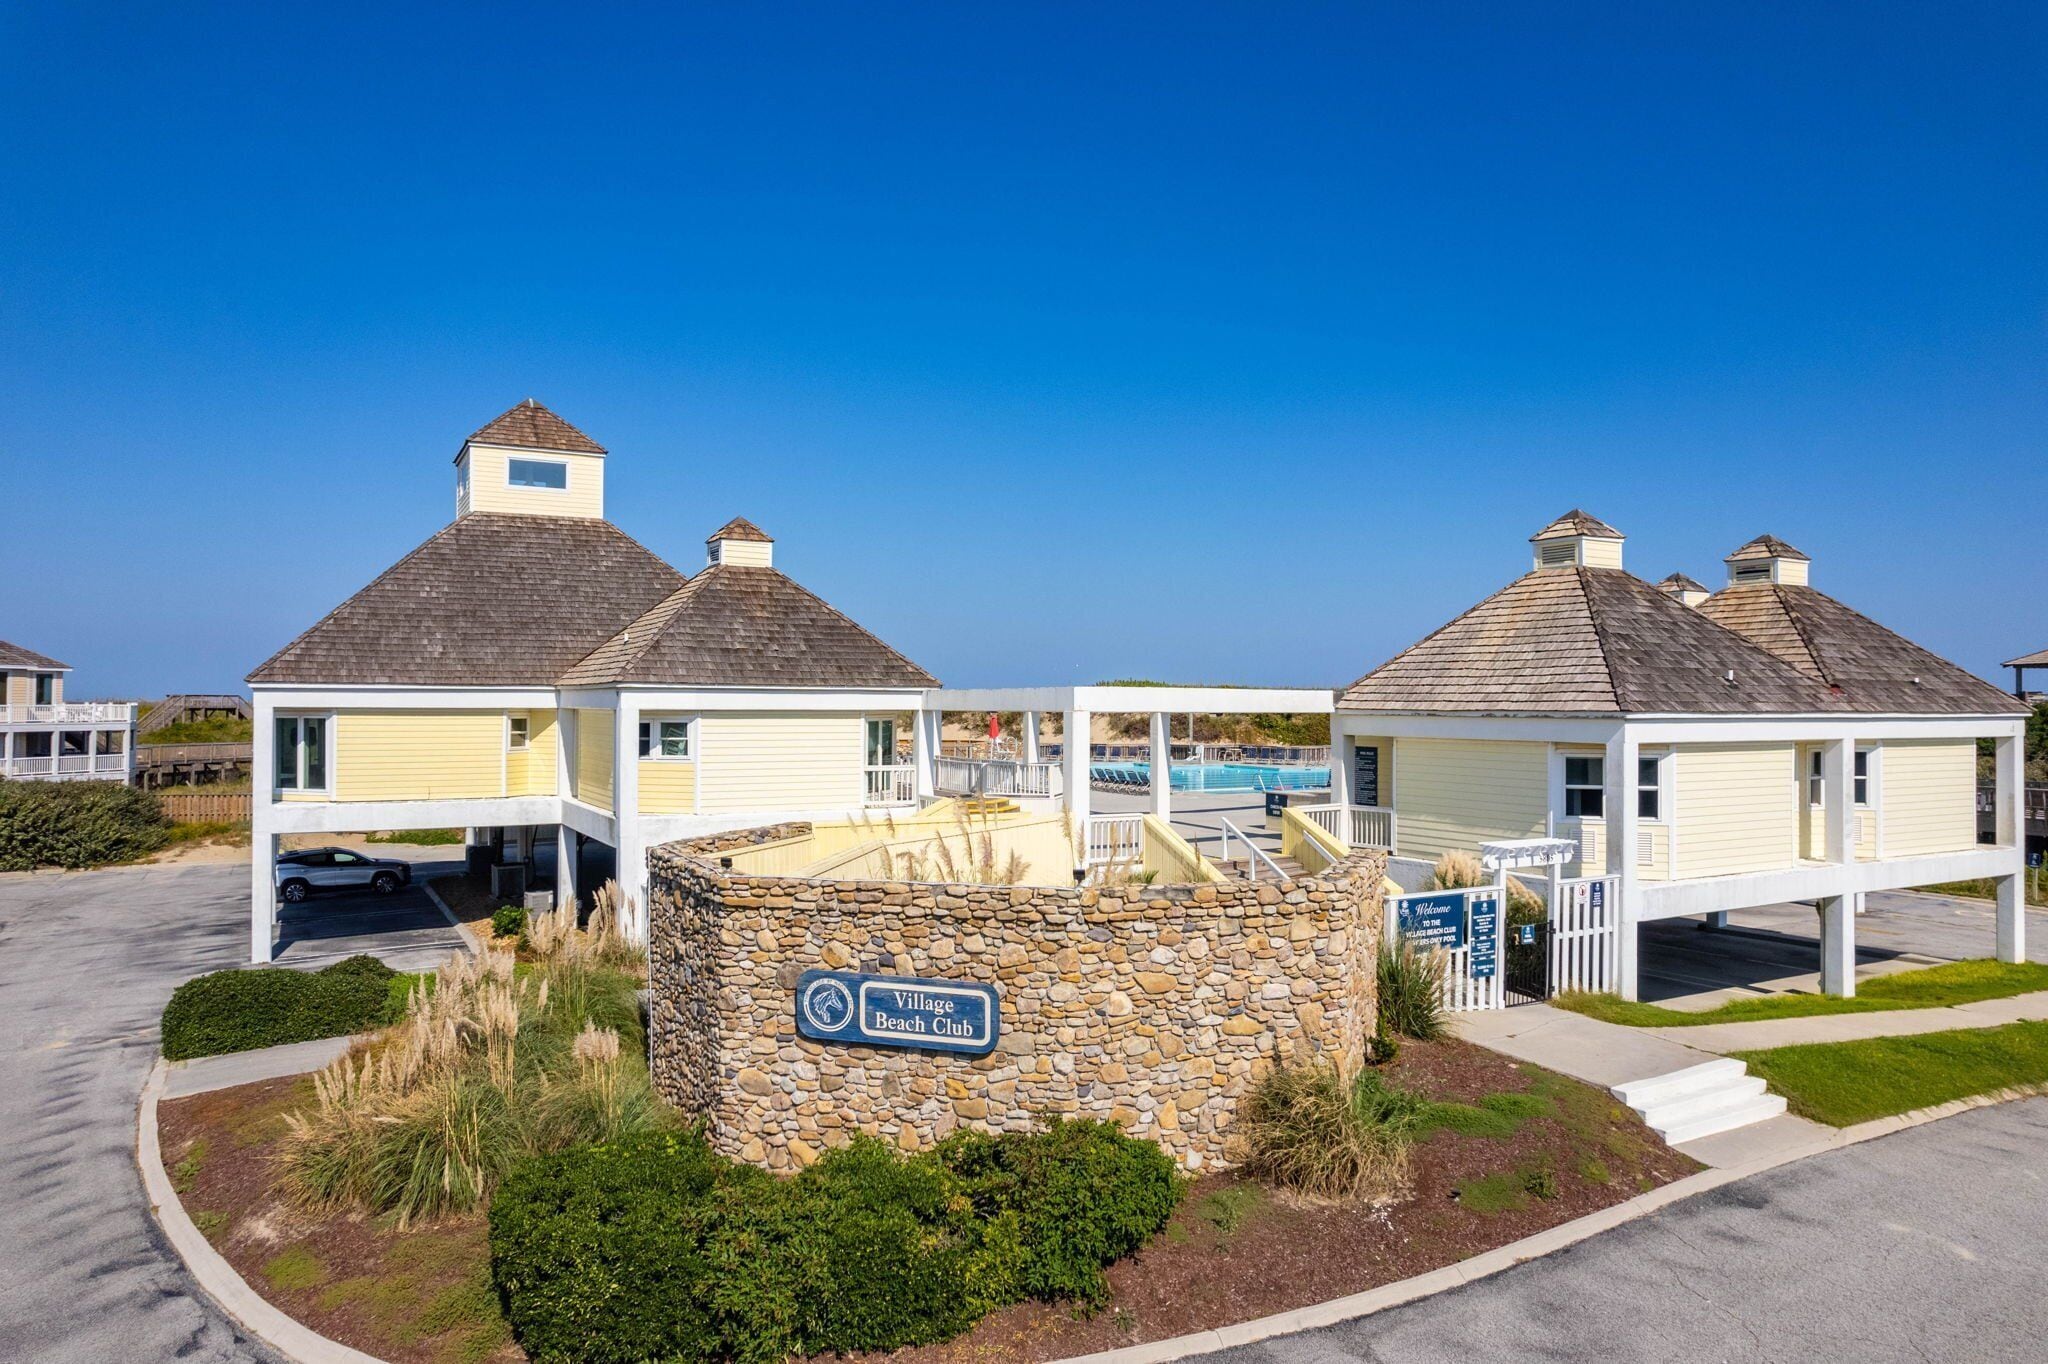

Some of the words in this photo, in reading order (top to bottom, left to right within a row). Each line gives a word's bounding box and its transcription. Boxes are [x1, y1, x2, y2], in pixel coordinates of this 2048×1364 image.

[1415, 902, 1451, 915] Welcome
[894, 991, 954, 1015] Village
[875, 1011, 925, 1032] Beach
[932, 1017, 973, 1036] Club
